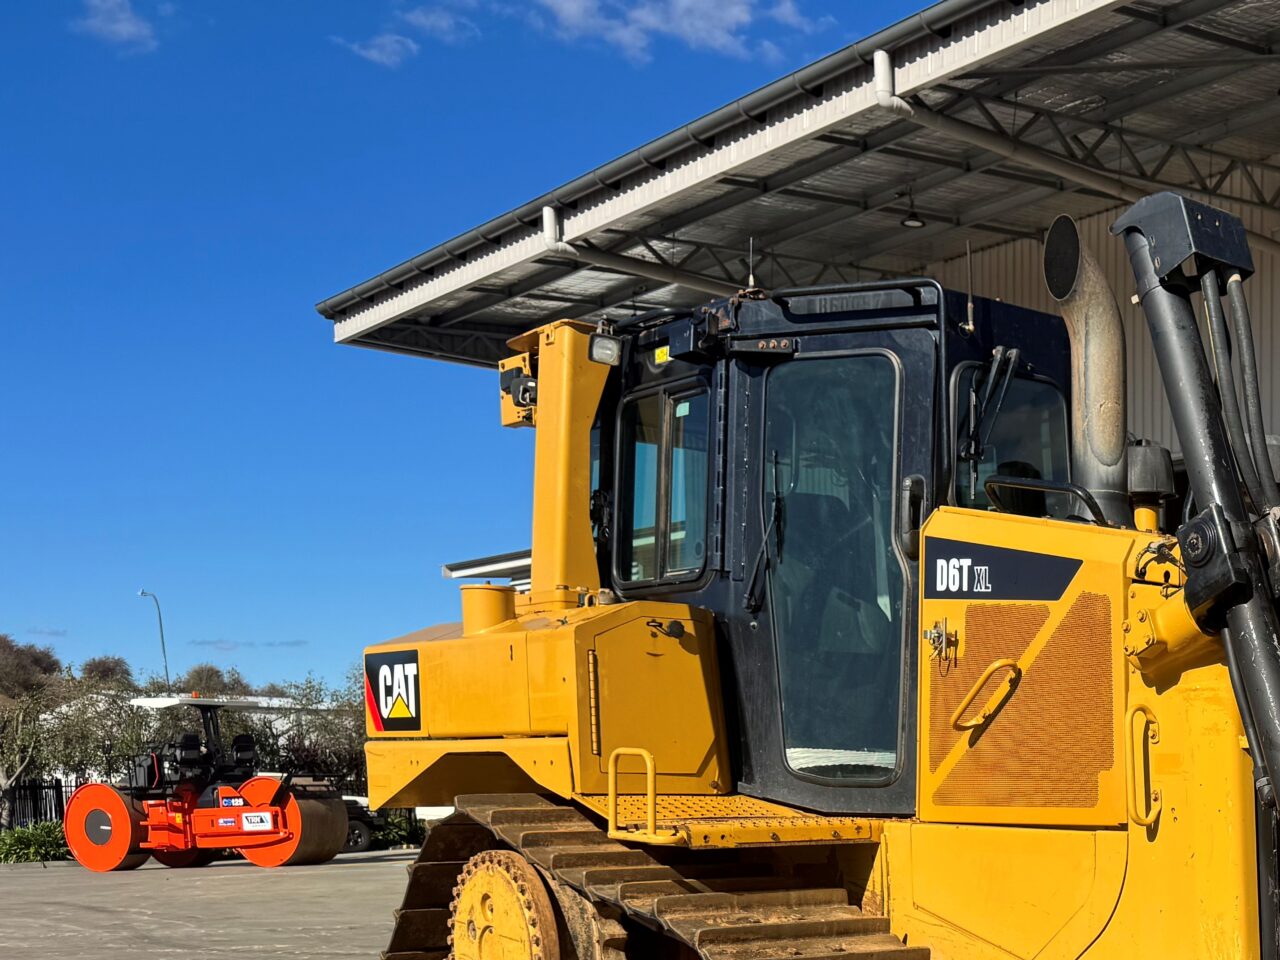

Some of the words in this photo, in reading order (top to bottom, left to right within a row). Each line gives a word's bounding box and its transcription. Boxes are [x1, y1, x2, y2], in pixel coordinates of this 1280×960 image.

[936, 558, 972, 592] D6T
[973, 566, 992, 592] XL
[379, 662, 418, 719] CAT
